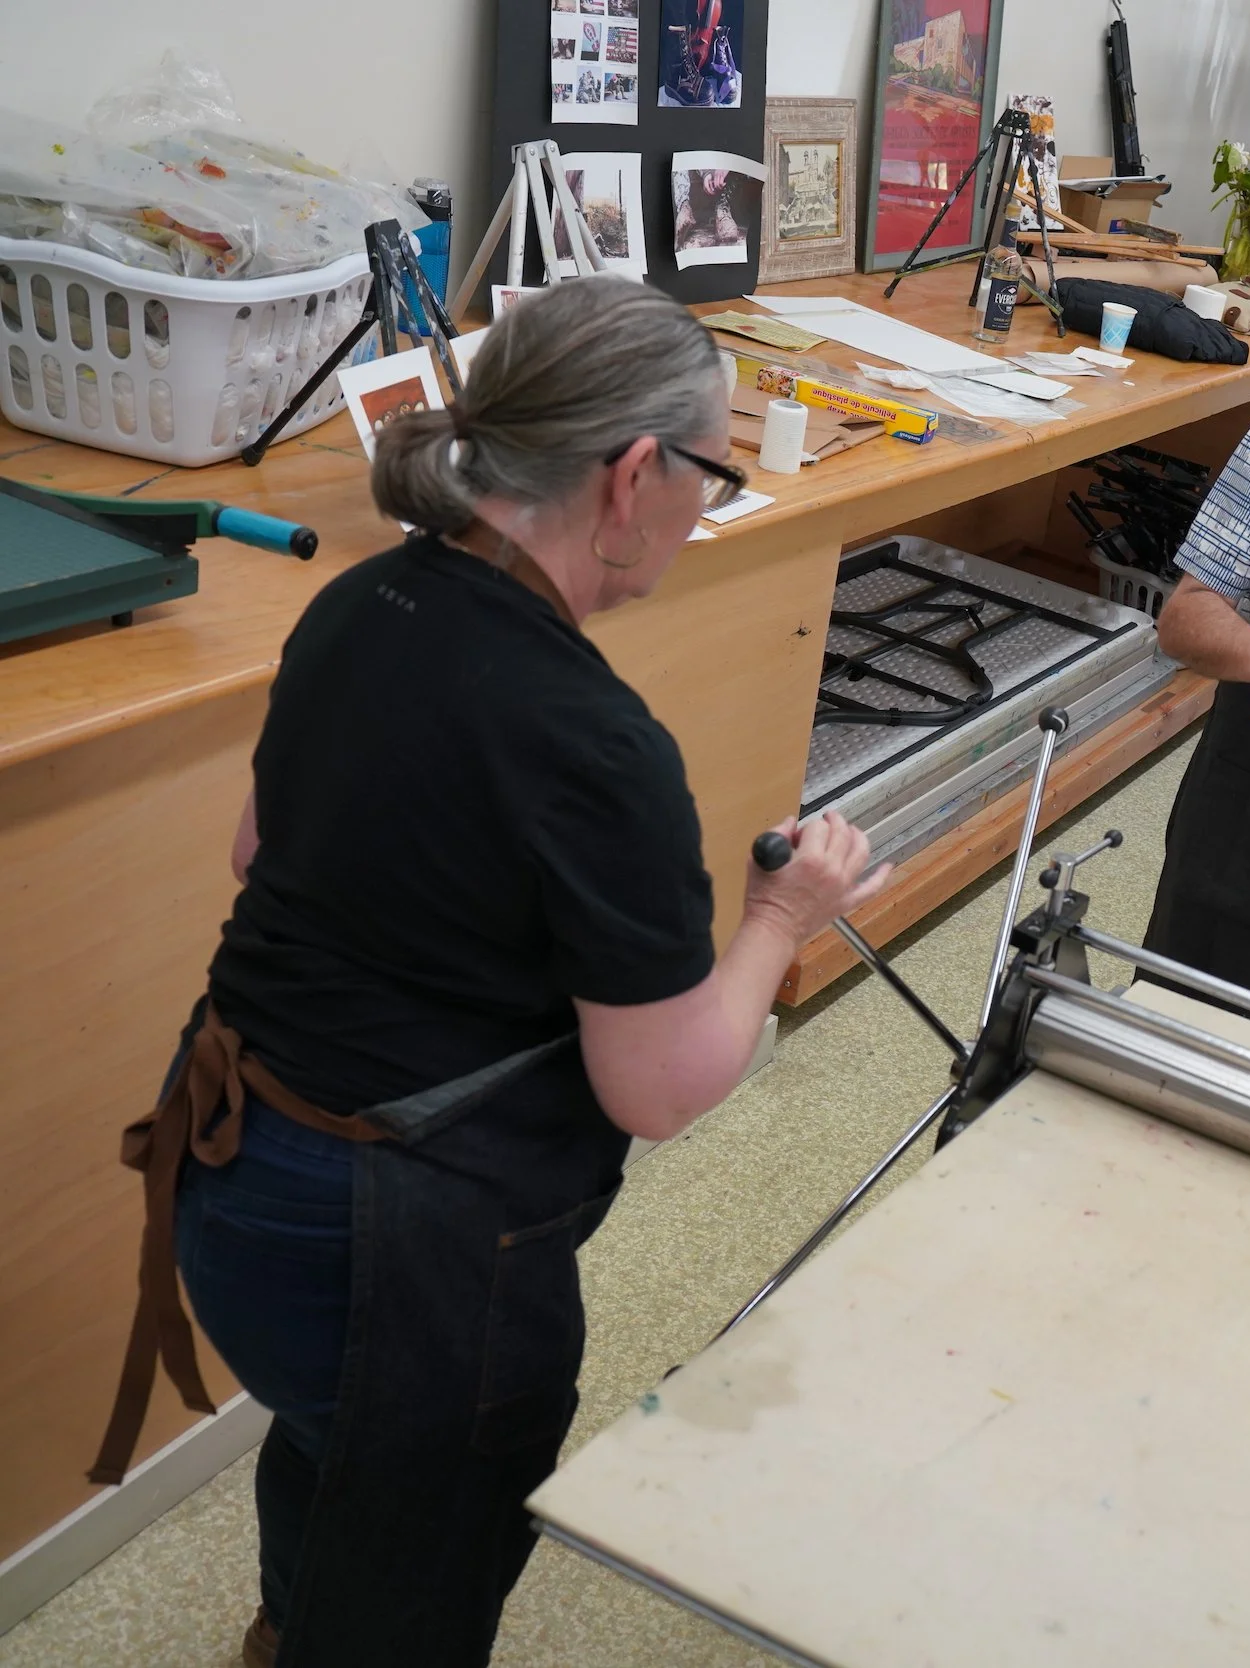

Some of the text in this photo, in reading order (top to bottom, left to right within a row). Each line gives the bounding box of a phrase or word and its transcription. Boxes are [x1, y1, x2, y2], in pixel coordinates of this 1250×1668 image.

[812, 388, 848, 404] plastique
[850, 400, 860, 408] de
[862, 404, 896, 420] Pellicule
